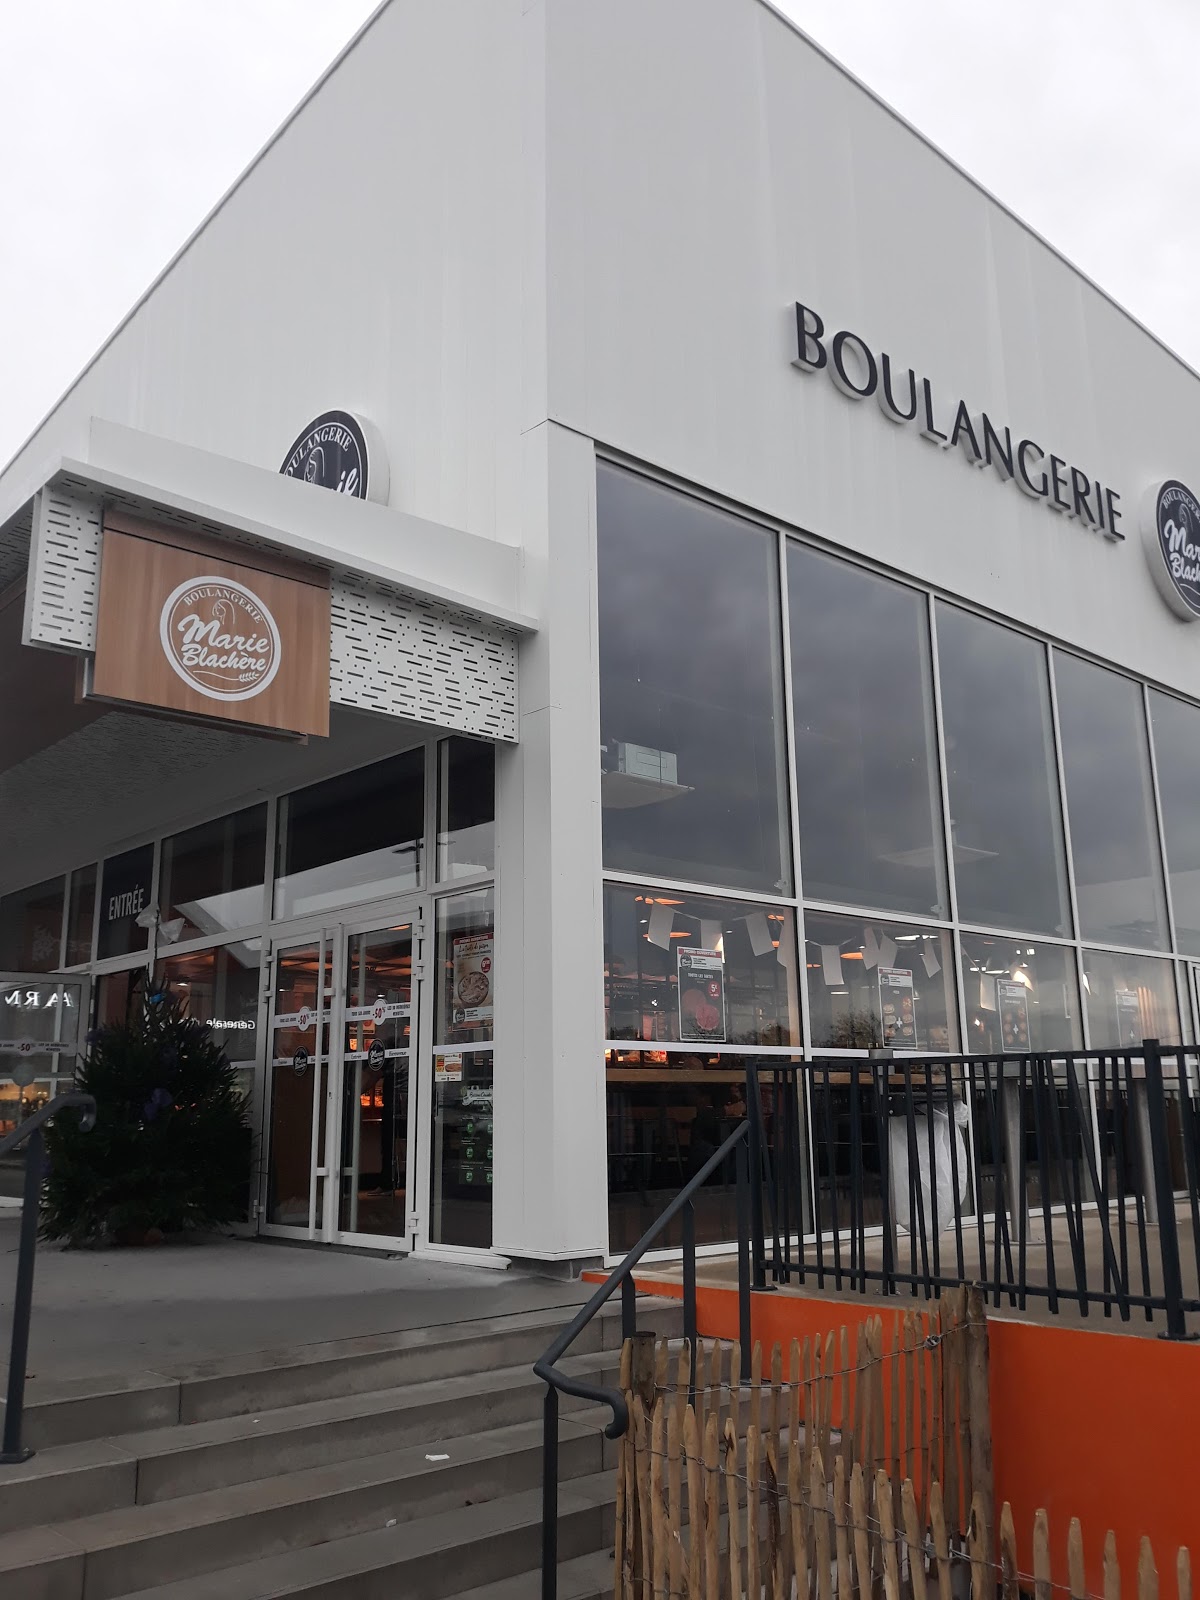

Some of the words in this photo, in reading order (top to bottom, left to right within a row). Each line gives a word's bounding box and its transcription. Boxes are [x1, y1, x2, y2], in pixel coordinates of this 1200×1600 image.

[792, 301, 1125, 541] BOULANGERIE
[183, 588, 263, 624] BOULANGERIE
[177, 614, 270, 653] Marie
[181, 643, 267, 671] Blachère
[109, 884, 144, 920] ENTRÉE
